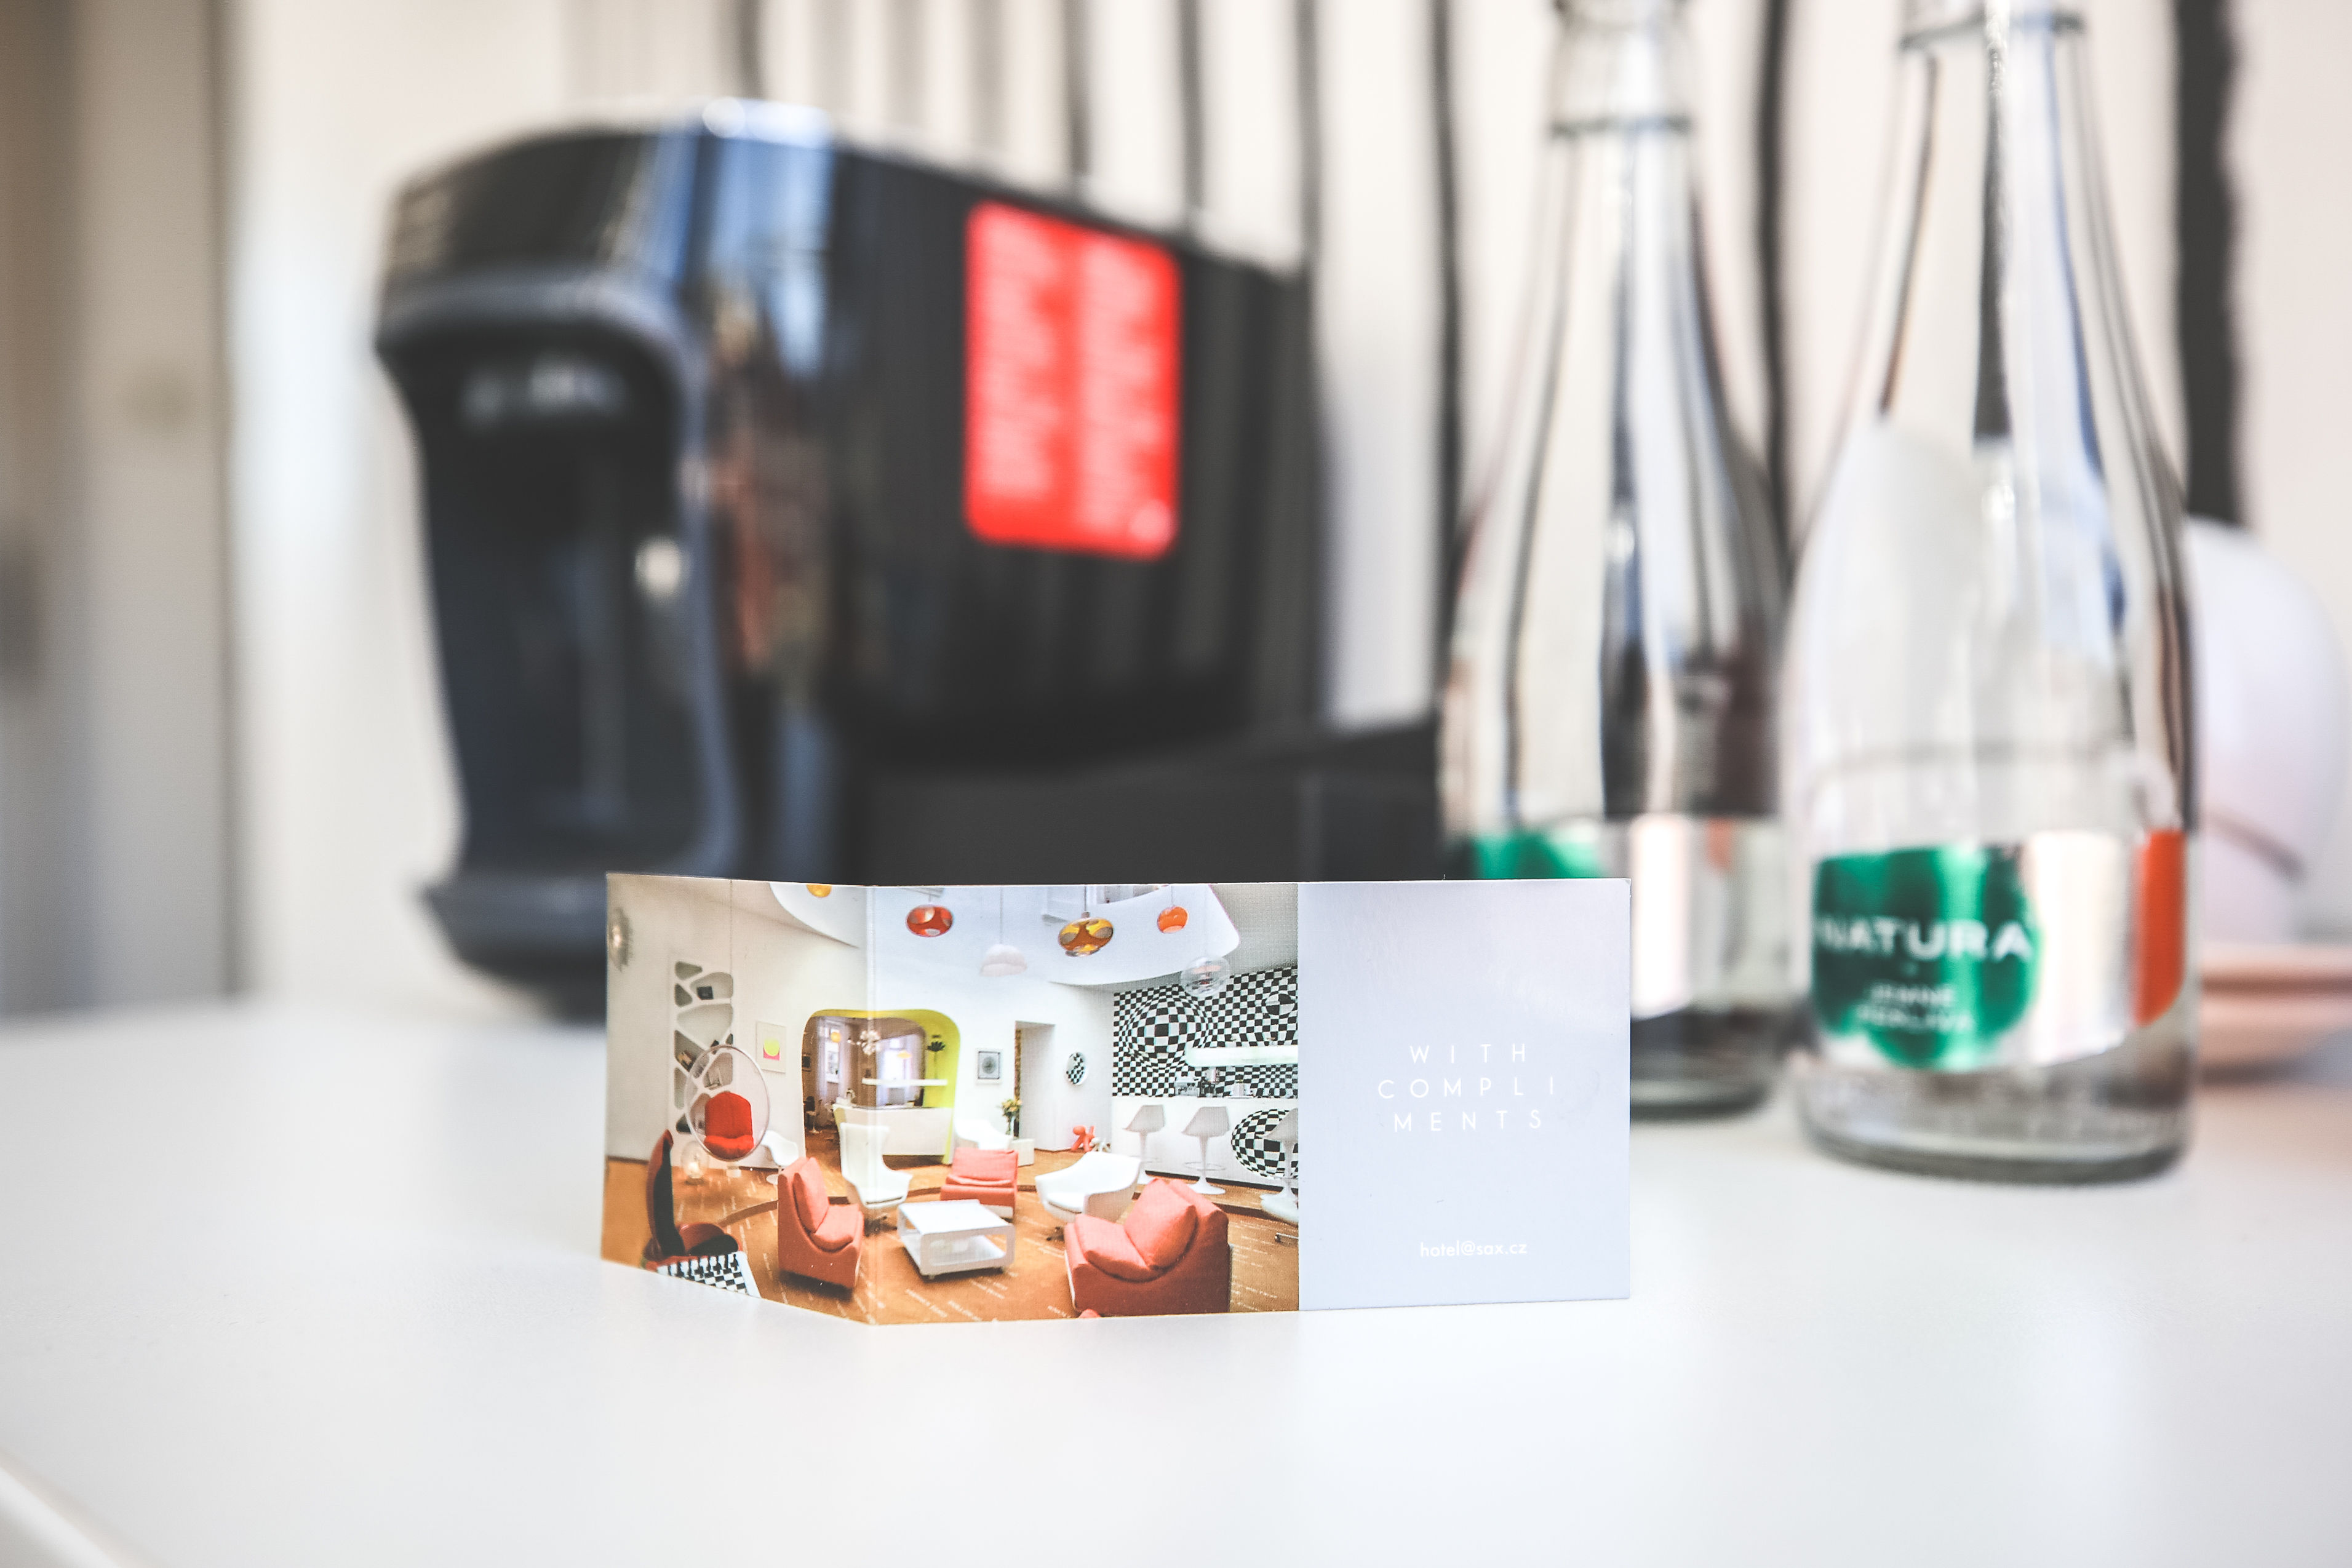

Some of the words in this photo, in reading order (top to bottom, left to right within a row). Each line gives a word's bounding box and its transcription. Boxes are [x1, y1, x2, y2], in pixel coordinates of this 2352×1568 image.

[1815, 914, 2033, 961] NATURA
[1409, 1043, 1526, 1064] WITH
[1377, 1076, 1554, 1099] COMPLI
[1394, 1109, 1542, 1132] MENTS
[1420, 1240, 1528, 1257] hotel@sax.cz
